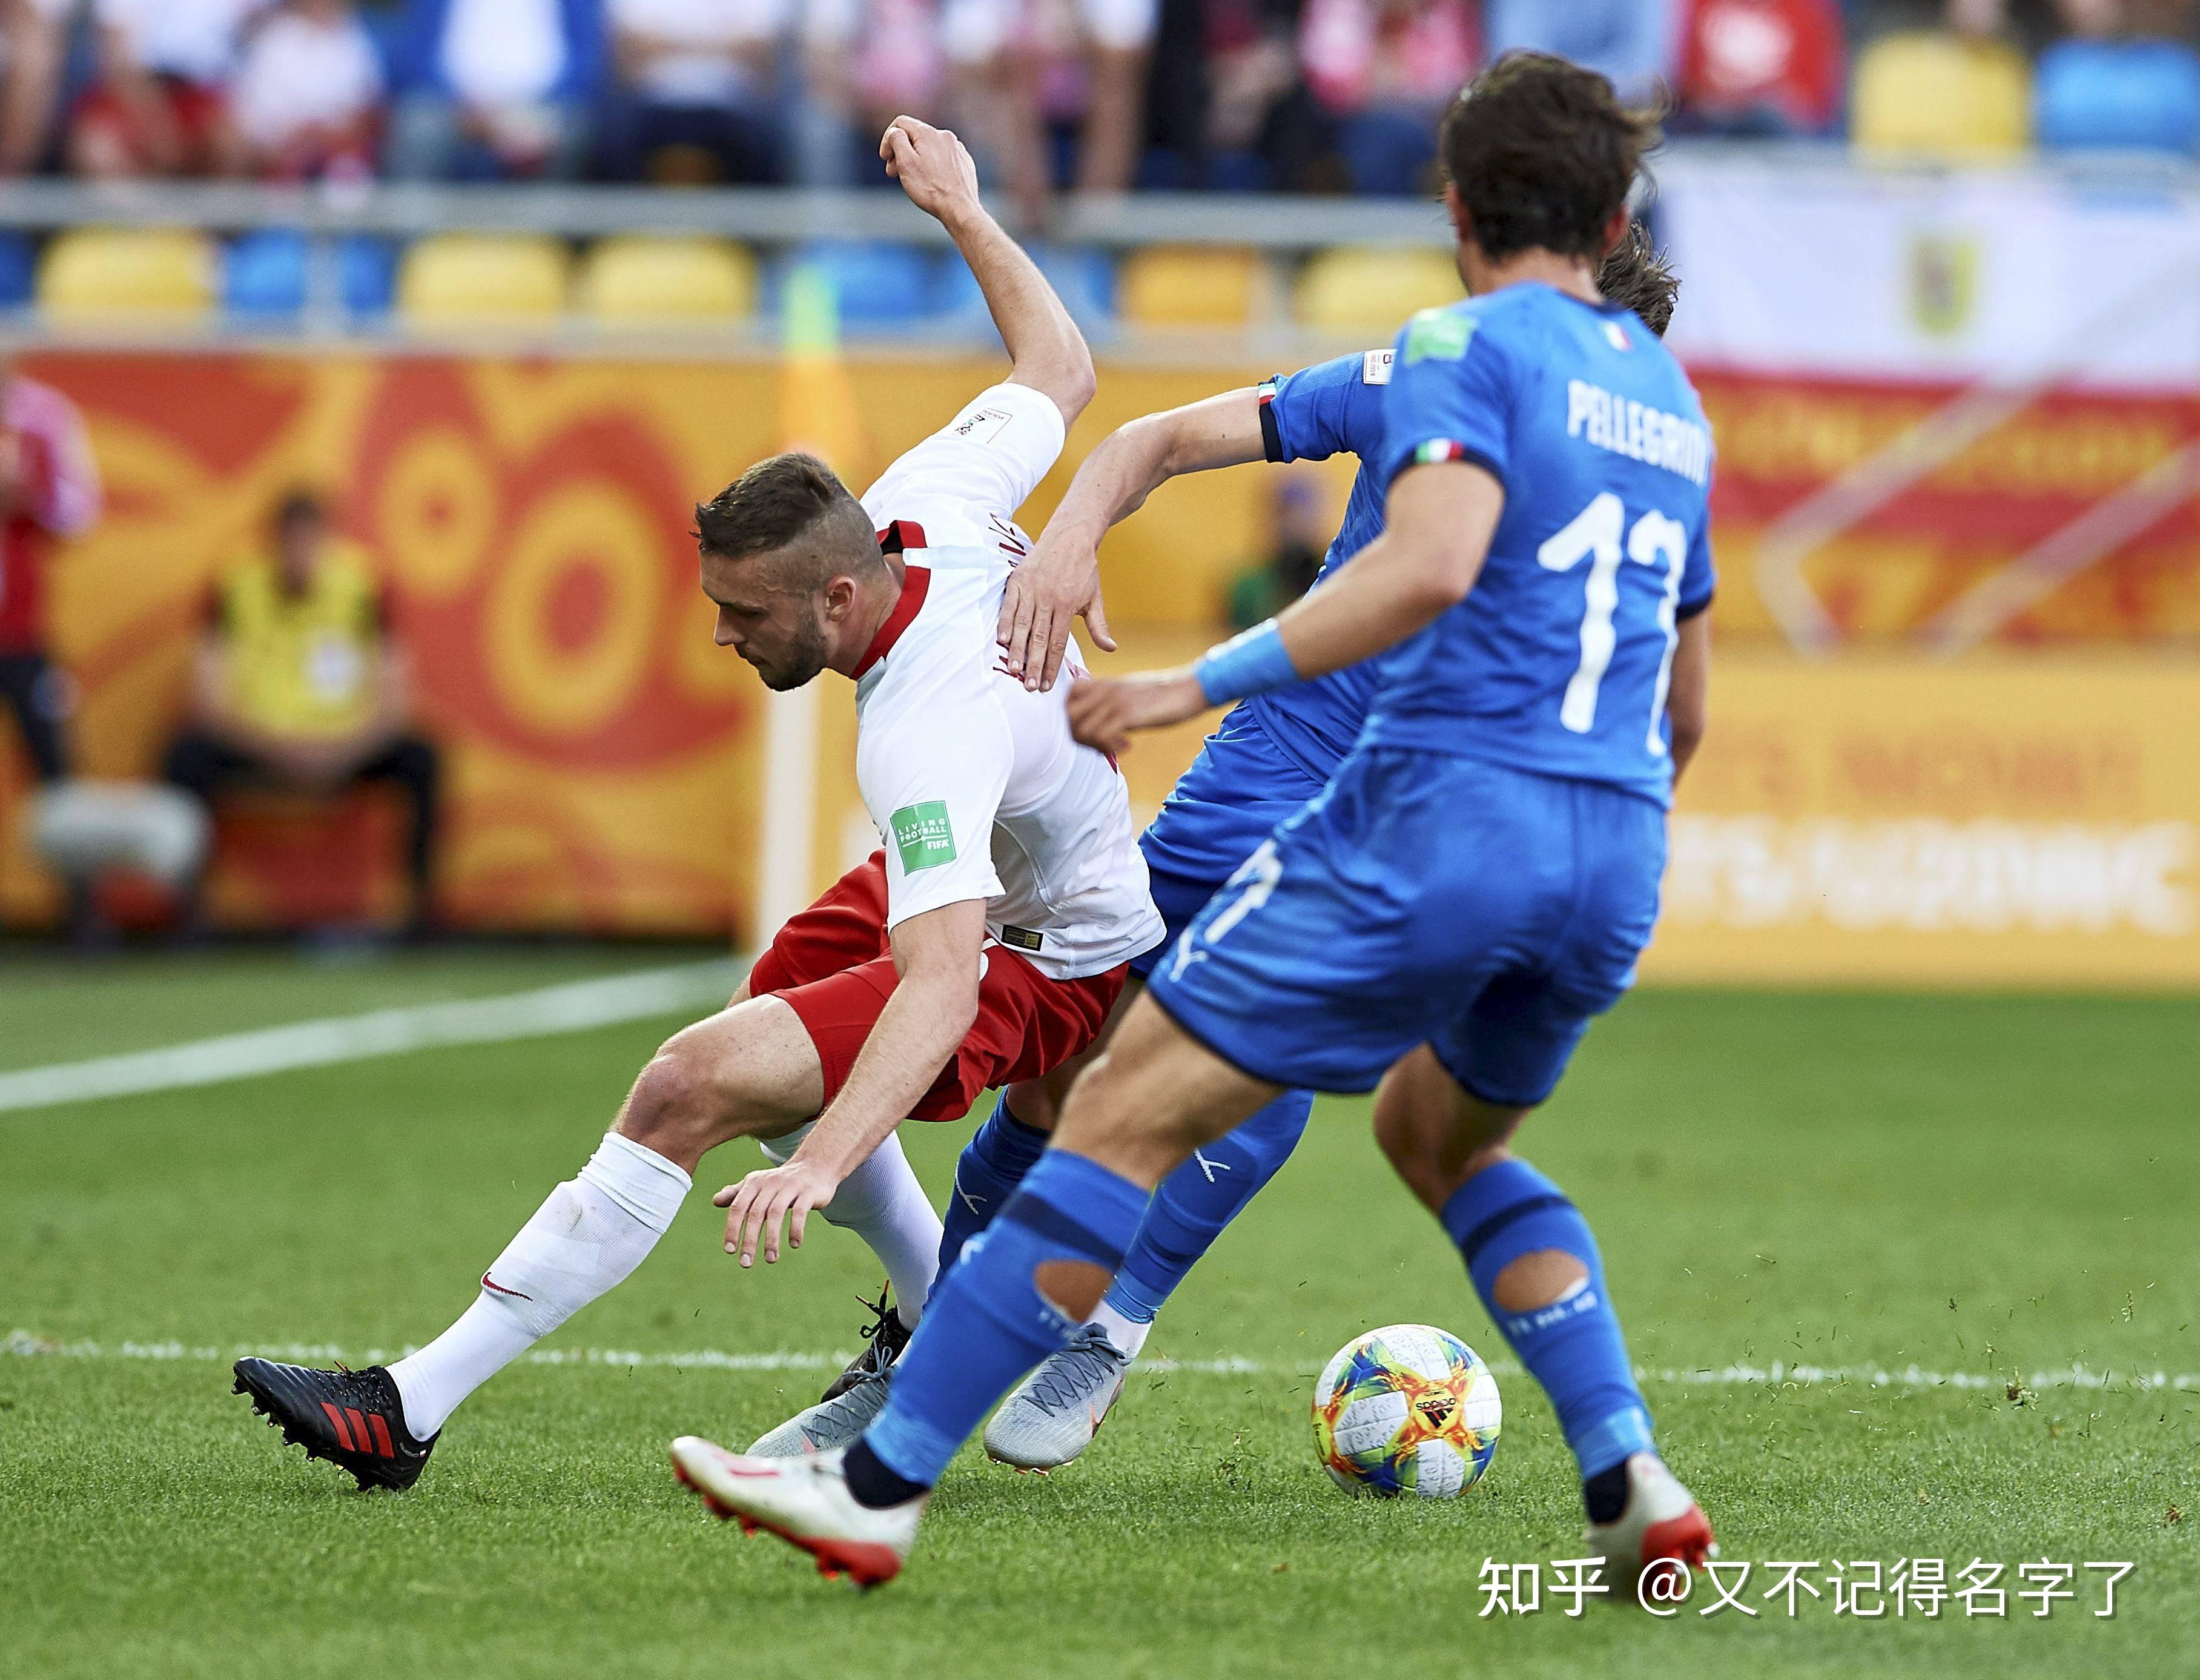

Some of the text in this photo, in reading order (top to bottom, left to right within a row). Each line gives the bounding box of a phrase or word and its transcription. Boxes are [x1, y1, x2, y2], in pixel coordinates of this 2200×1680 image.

[898, 818, 945, 835] LIVING
[900, 825, 946, 843] FOOTBALL
[927, 839, 950, 850] FIFA
